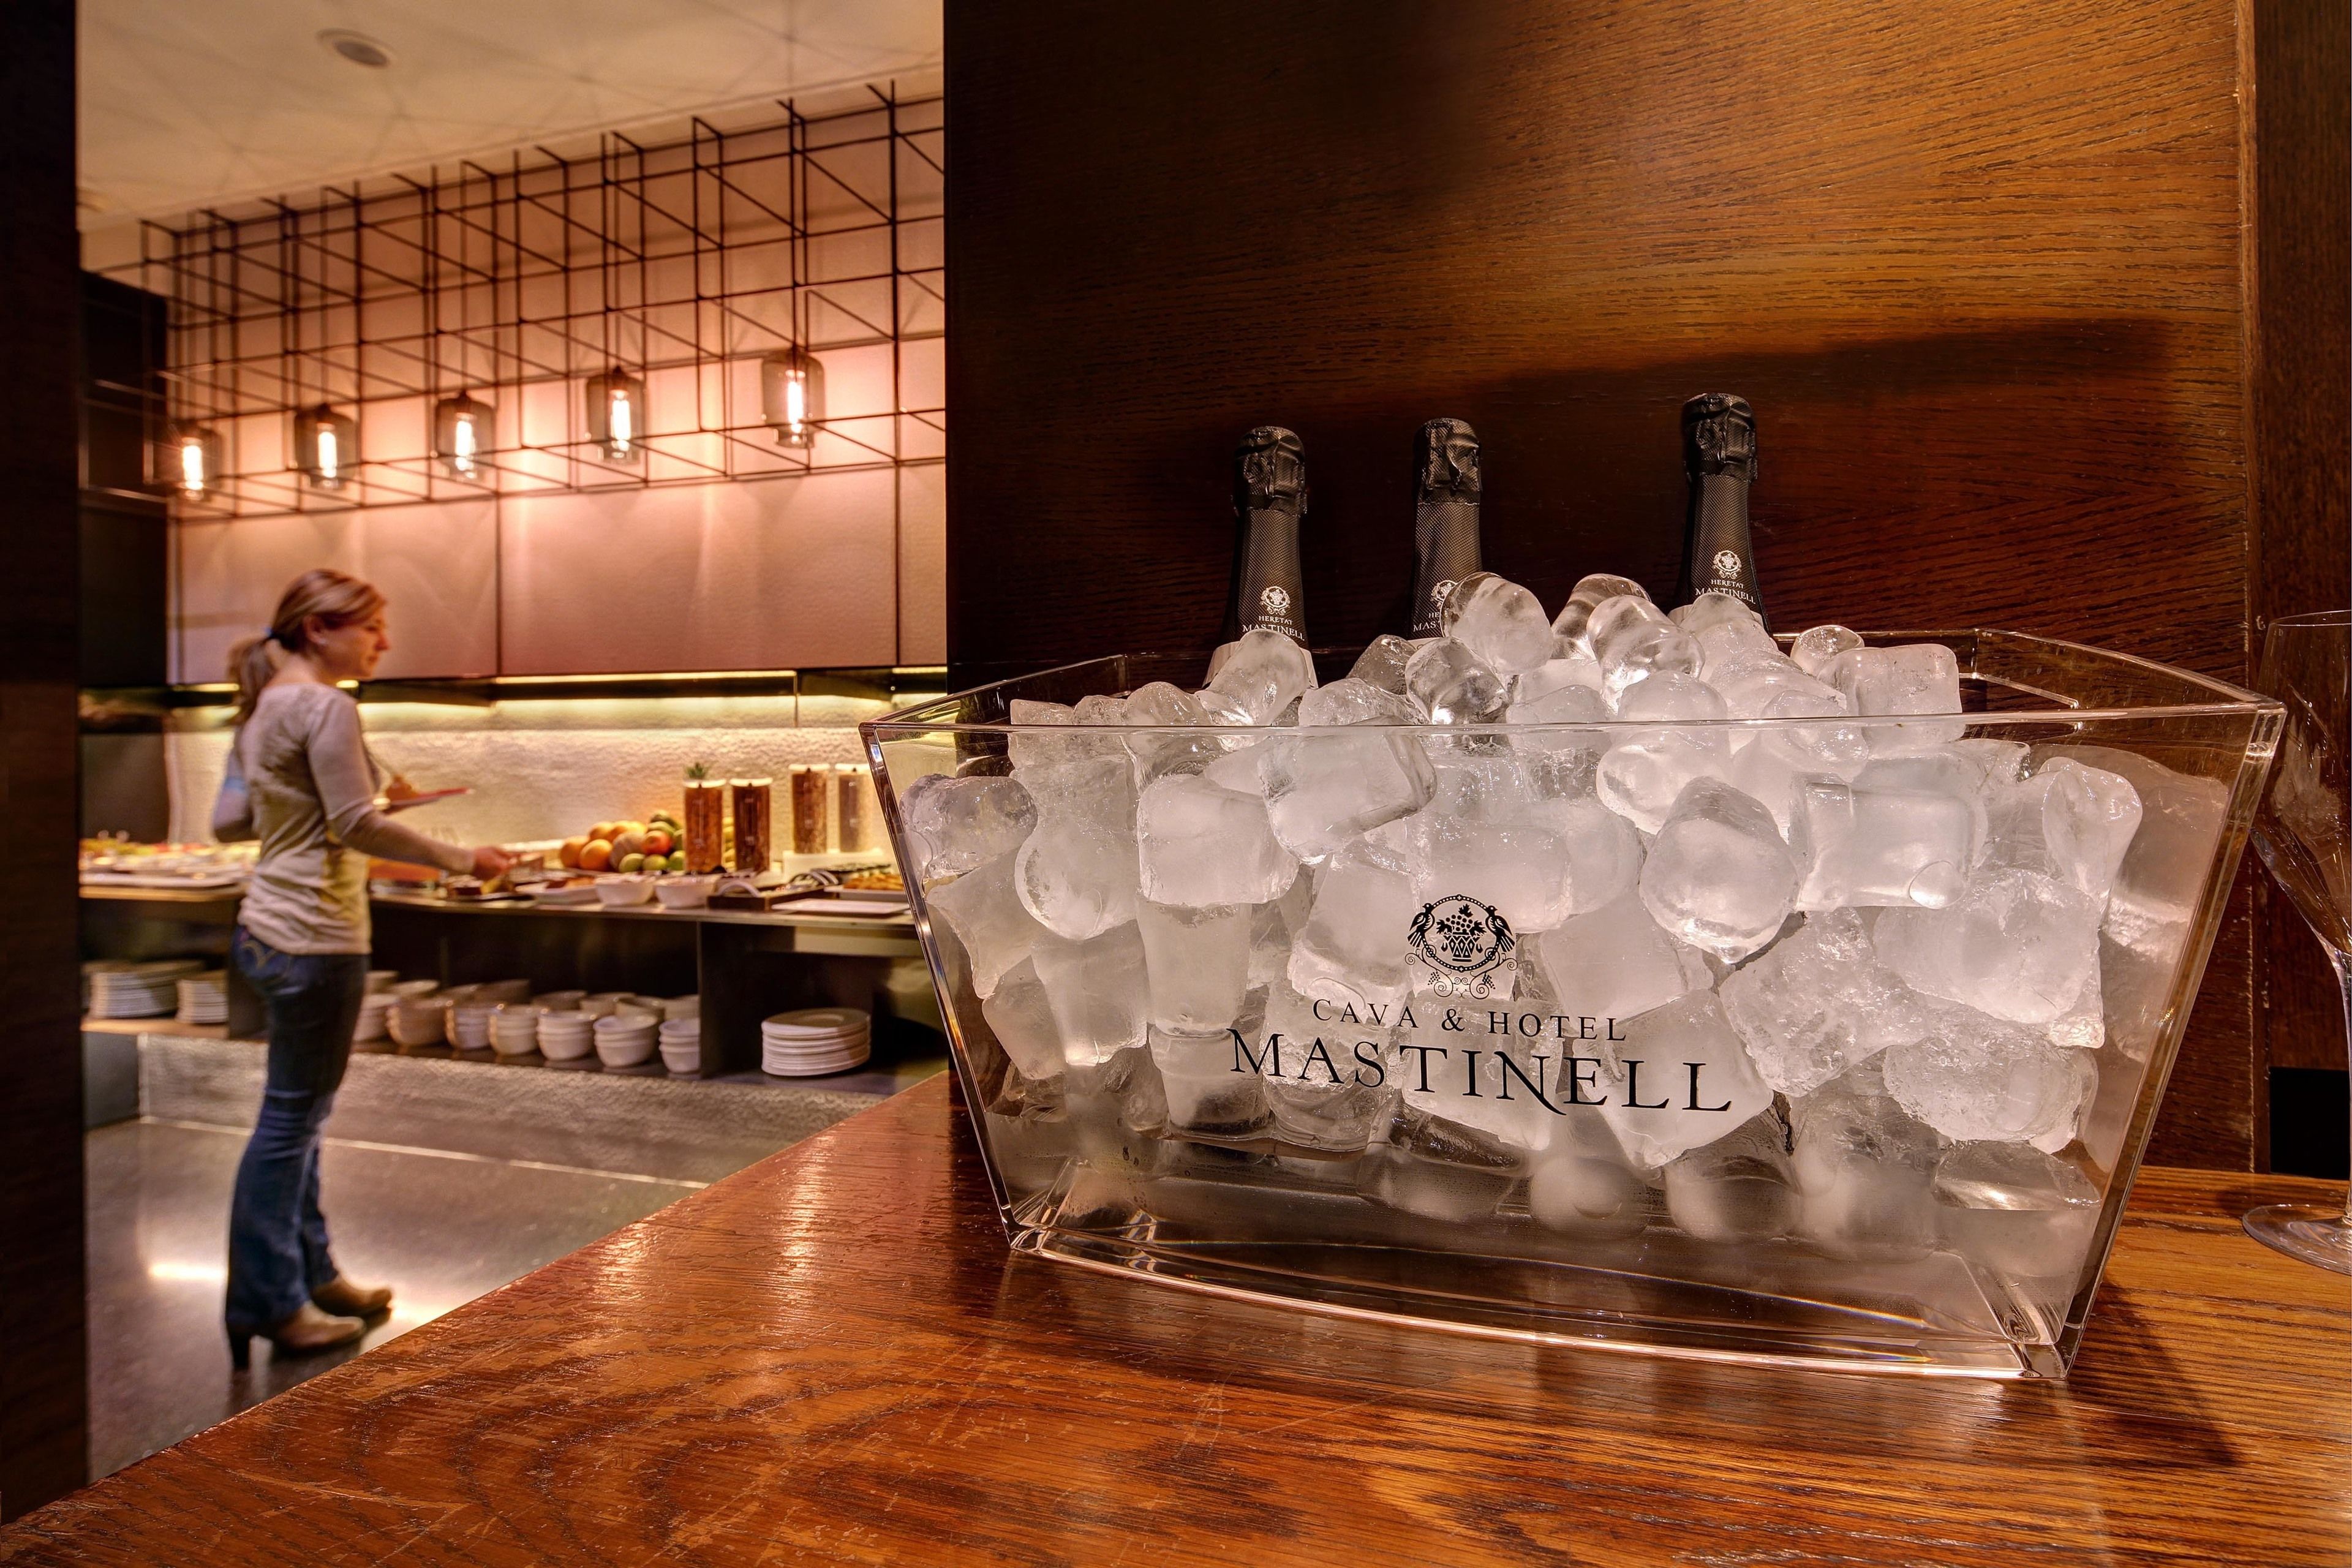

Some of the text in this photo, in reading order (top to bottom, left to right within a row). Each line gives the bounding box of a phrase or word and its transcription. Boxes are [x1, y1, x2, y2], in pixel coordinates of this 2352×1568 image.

[1711, 579, 1744, 589] HERETAT
[1259, 616, 1293, 625] HERETAT
[1313, 999, 1627, 1041] CAVA & HOTEL
[1226, 1028, 1732, 1115] MASTINELL
